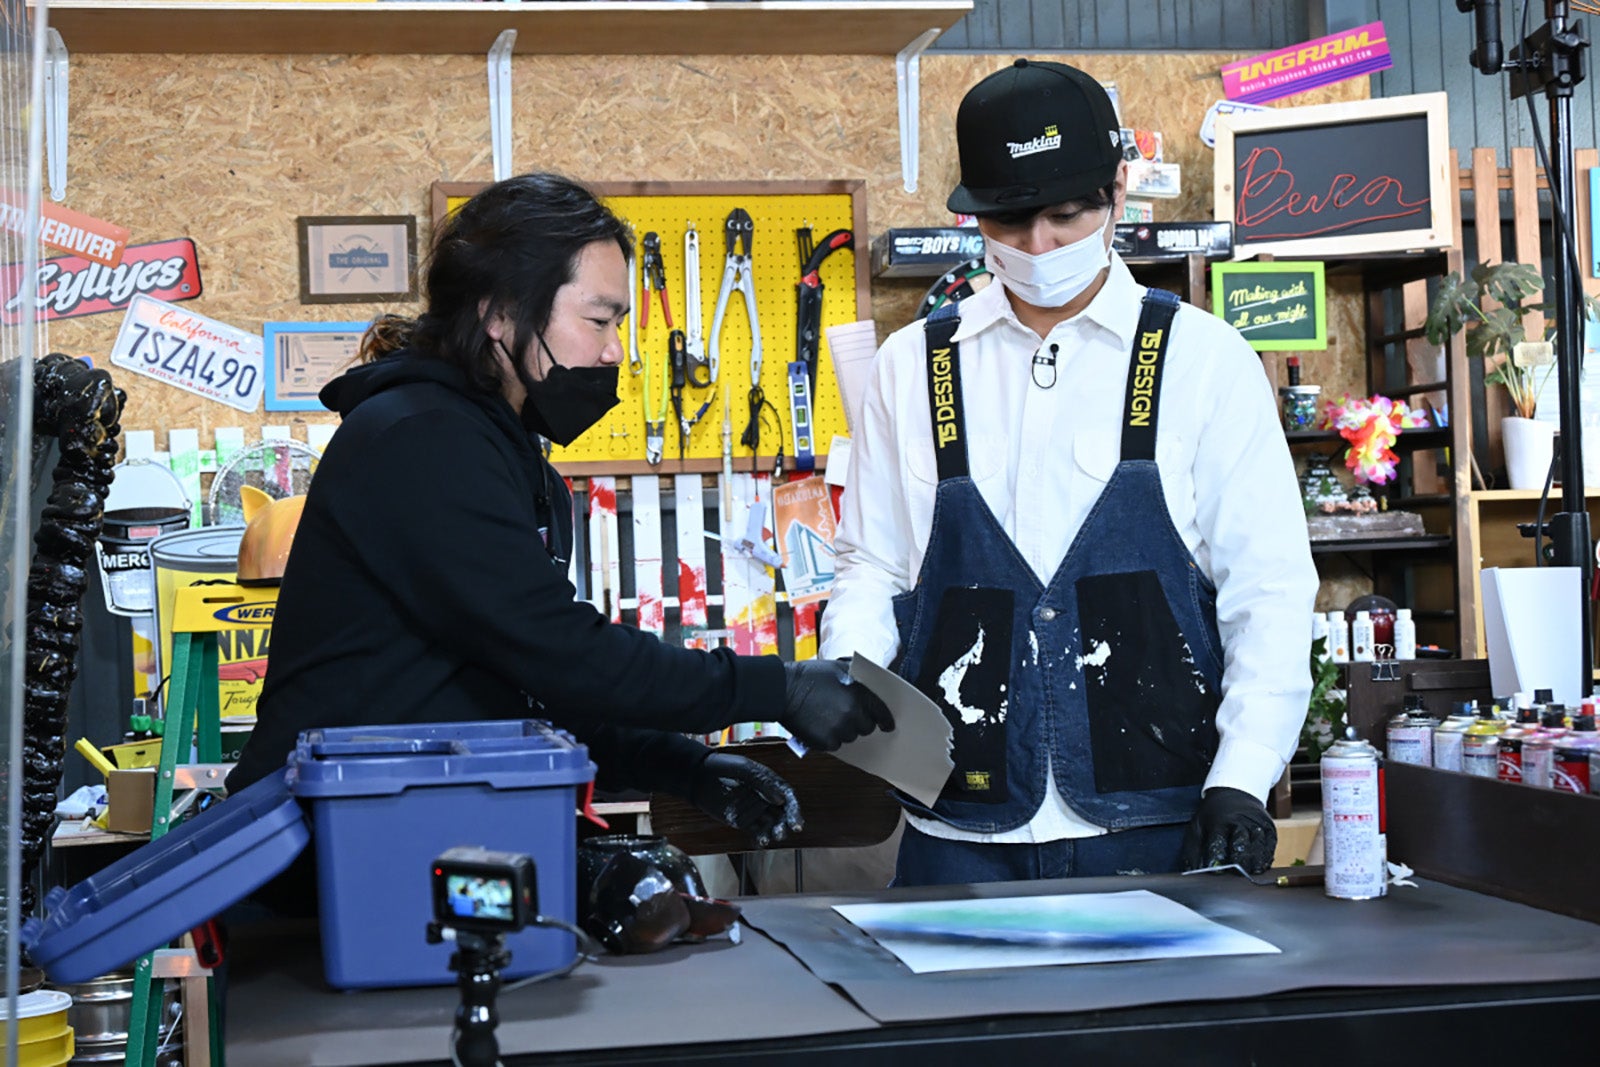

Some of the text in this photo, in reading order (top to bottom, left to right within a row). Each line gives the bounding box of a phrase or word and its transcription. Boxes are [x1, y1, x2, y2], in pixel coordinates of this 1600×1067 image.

[1236, 32, 1370, 82] INGRAM
[352, 256, 382, 264] ORIGINAL
[1228, 280, 1307, 304] Making with
[160, 310, 246, 354] California
[128, 323, 257, 397] 7SZA490
[933, 348, 955, 421] DESIGN
[1130, 351, 1159, 427] DESIGN
